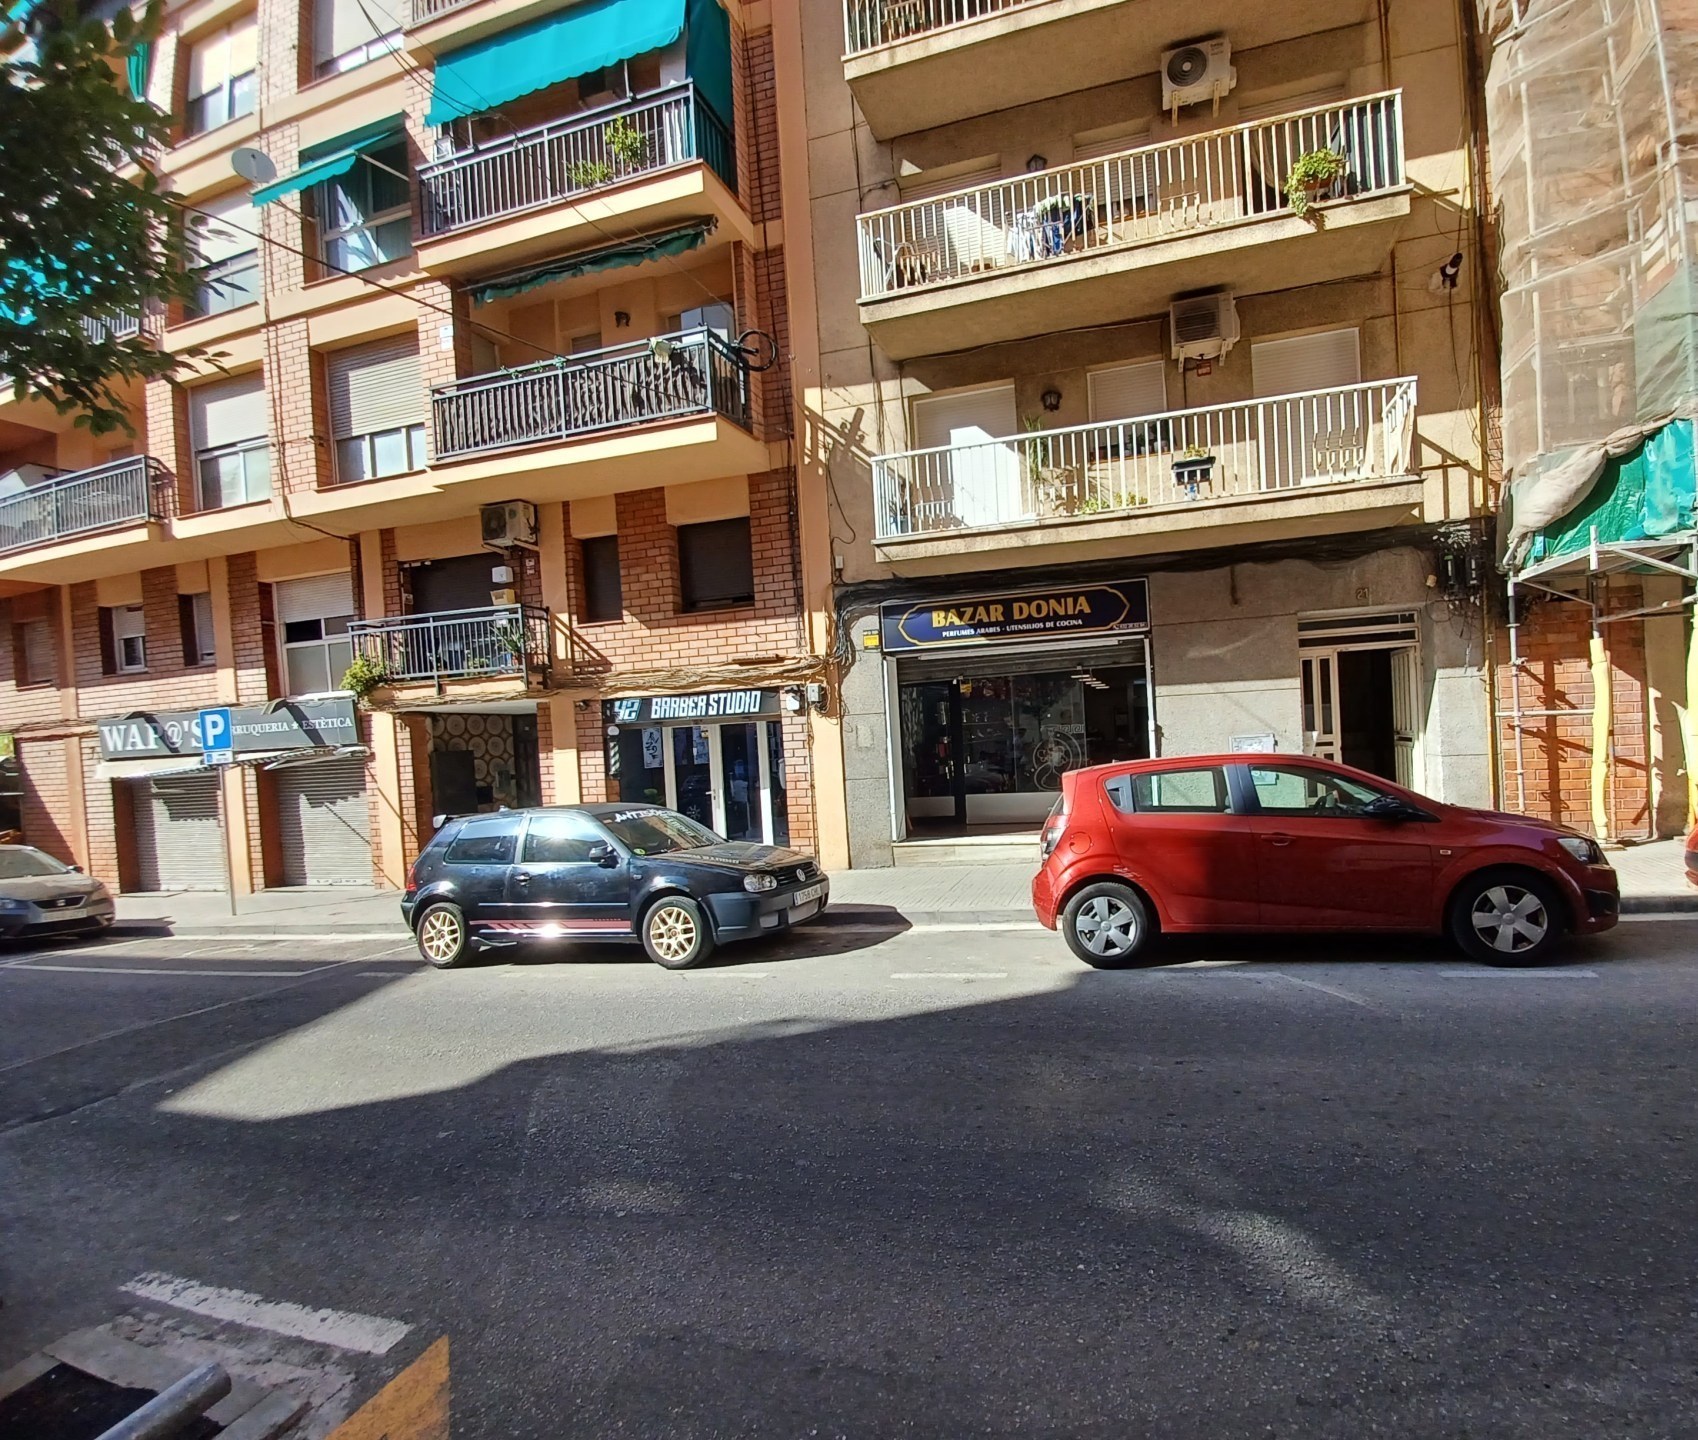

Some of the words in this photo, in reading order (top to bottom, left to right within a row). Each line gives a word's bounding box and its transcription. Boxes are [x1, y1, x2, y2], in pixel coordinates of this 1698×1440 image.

[1356, 588, 1369, 600] 21
[932, 605, 1004, 628] BAZAR
[1013, 596, 1091, 620] DONIA
[942, 628, 975, 638] PERFUMES
[1006, 621, 1044, 632] UTENSILIOS
[1056, 618, 1083, 627] COCINA
[651, 695, 708, 719] BARBER
[708, 690, 762, 716] STUDIO
[204, 713, 225, 747] P
[232, 722, 290, 737] RRUQUERIA
[302, 717, 353, 730] ESTÈTICA
